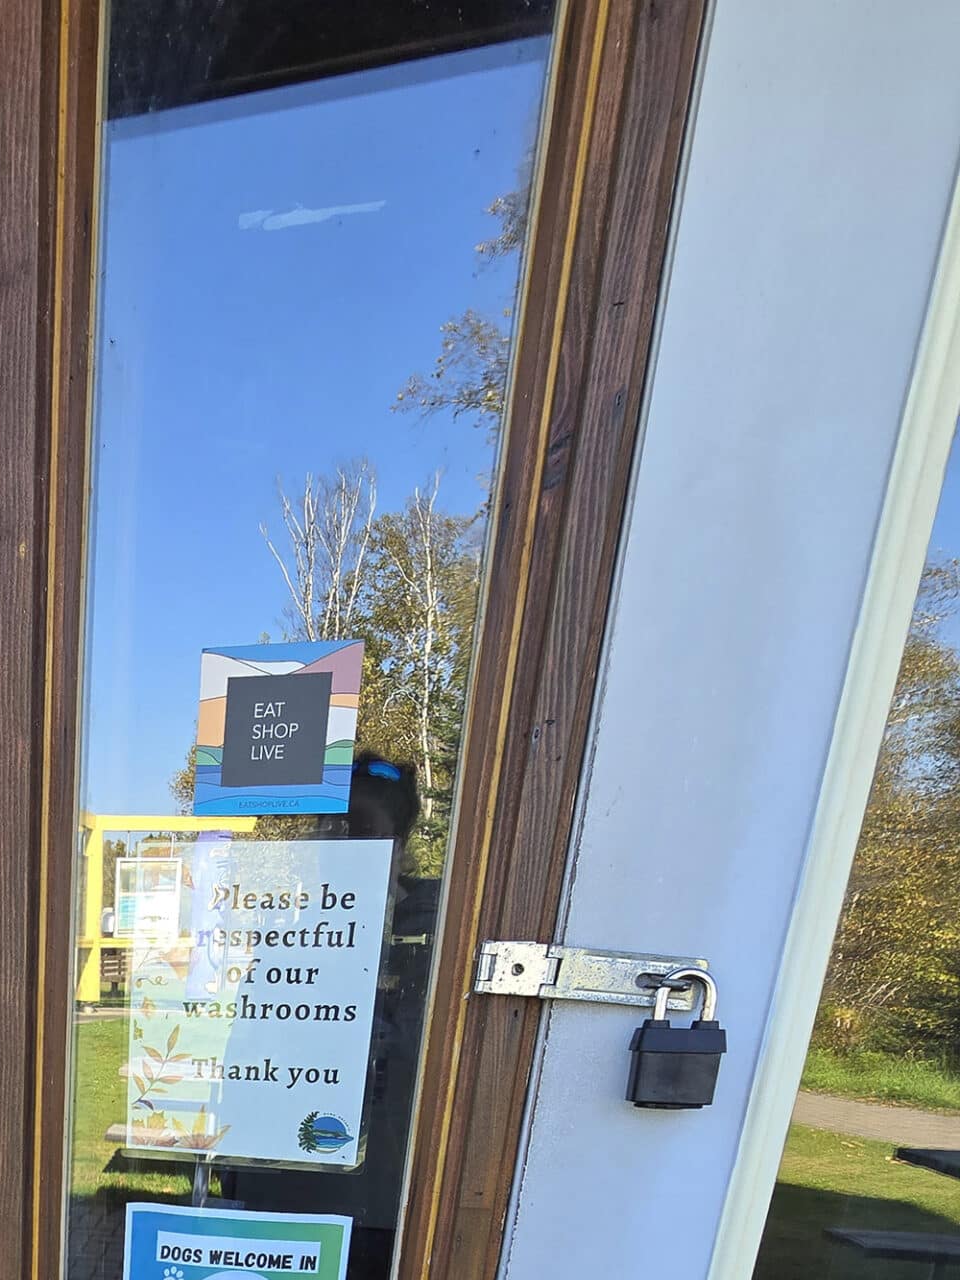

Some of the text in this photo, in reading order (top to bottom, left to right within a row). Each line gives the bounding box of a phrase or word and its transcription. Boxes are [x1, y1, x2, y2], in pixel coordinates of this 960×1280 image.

[253, 702, 286, 718] EAT
[251, 723, 299, 740] SHOP
[250, 744, 285, 761] LIVE
[211, 884, 357, 911] Please be
[196, 922, 356, 954] respectful
[226, 958, 319, 985] of our
[182, 995, 357, 1023] washrooms
[191, 1059, 340, 1089] Thank you
[160, 1245, 318, 1271] DOGS WELCOME IN
